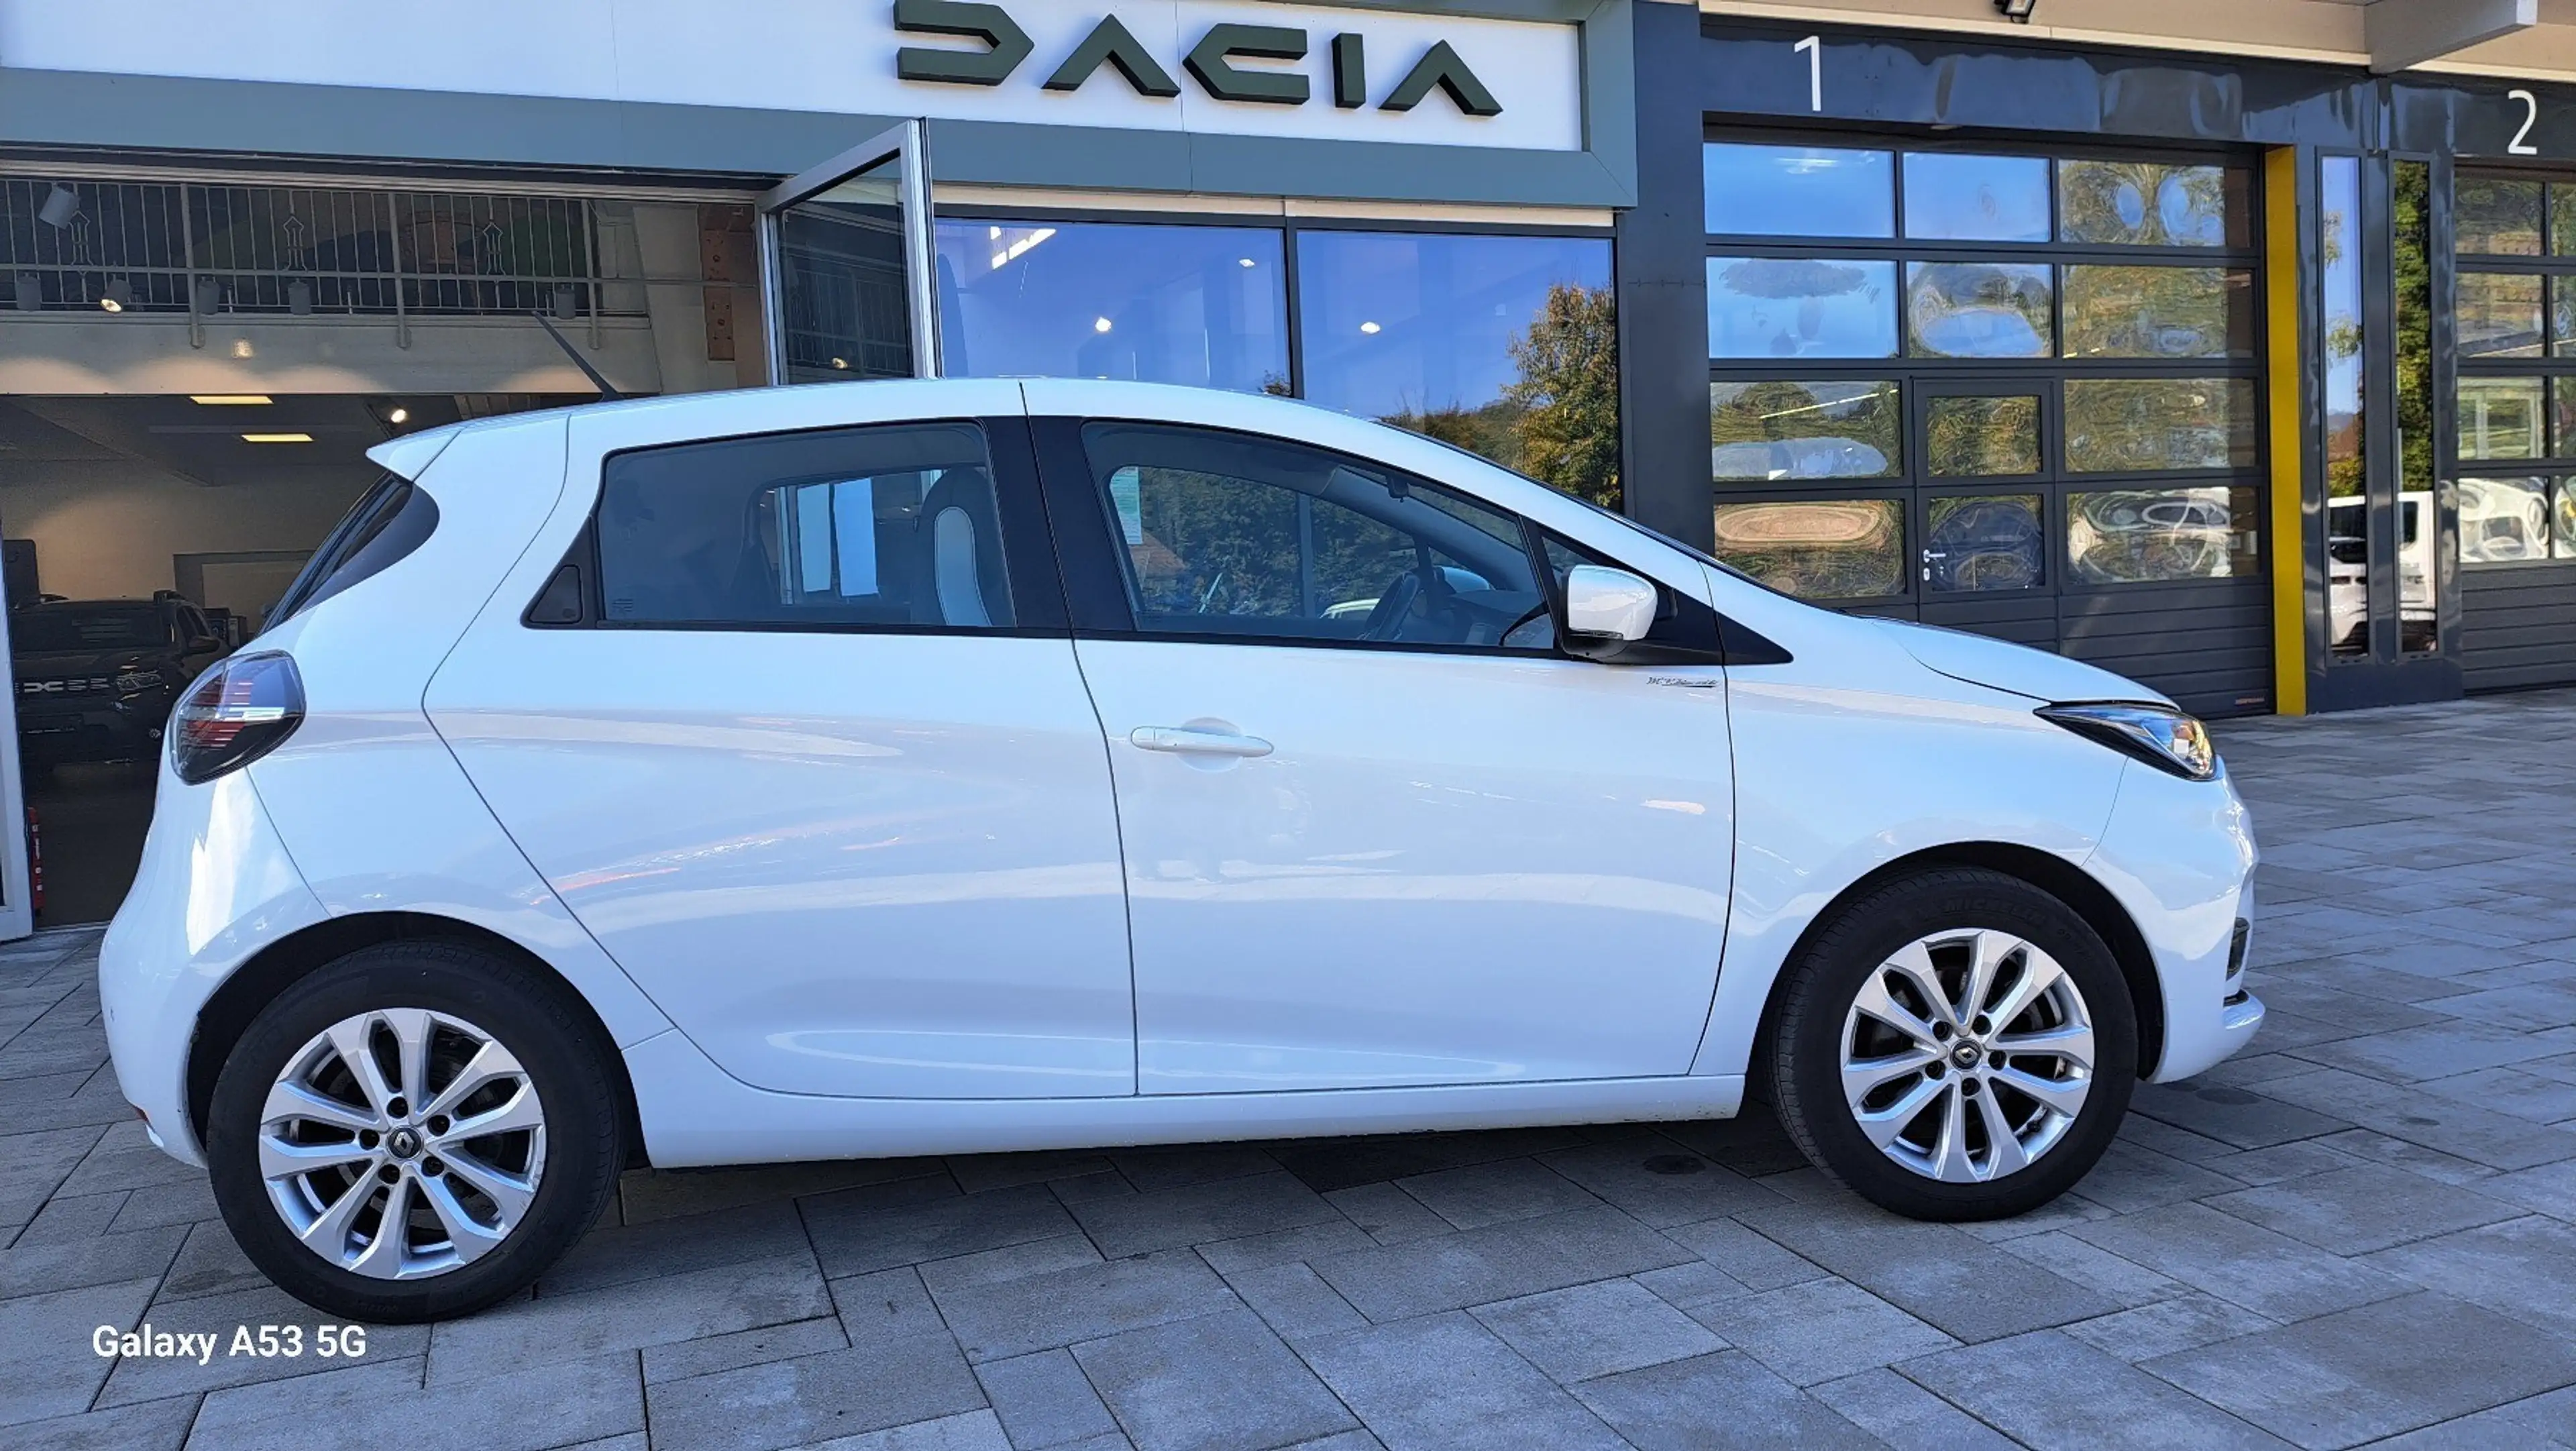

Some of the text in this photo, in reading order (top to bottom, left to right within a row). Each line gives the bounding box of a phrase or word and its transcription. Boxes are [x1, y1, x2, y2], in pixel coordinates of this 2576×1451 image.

[894, 0, 1503, 116] DACIA
[1794, 36, 1821, 111] 1
[2508, 89, 2538, 155] 2
